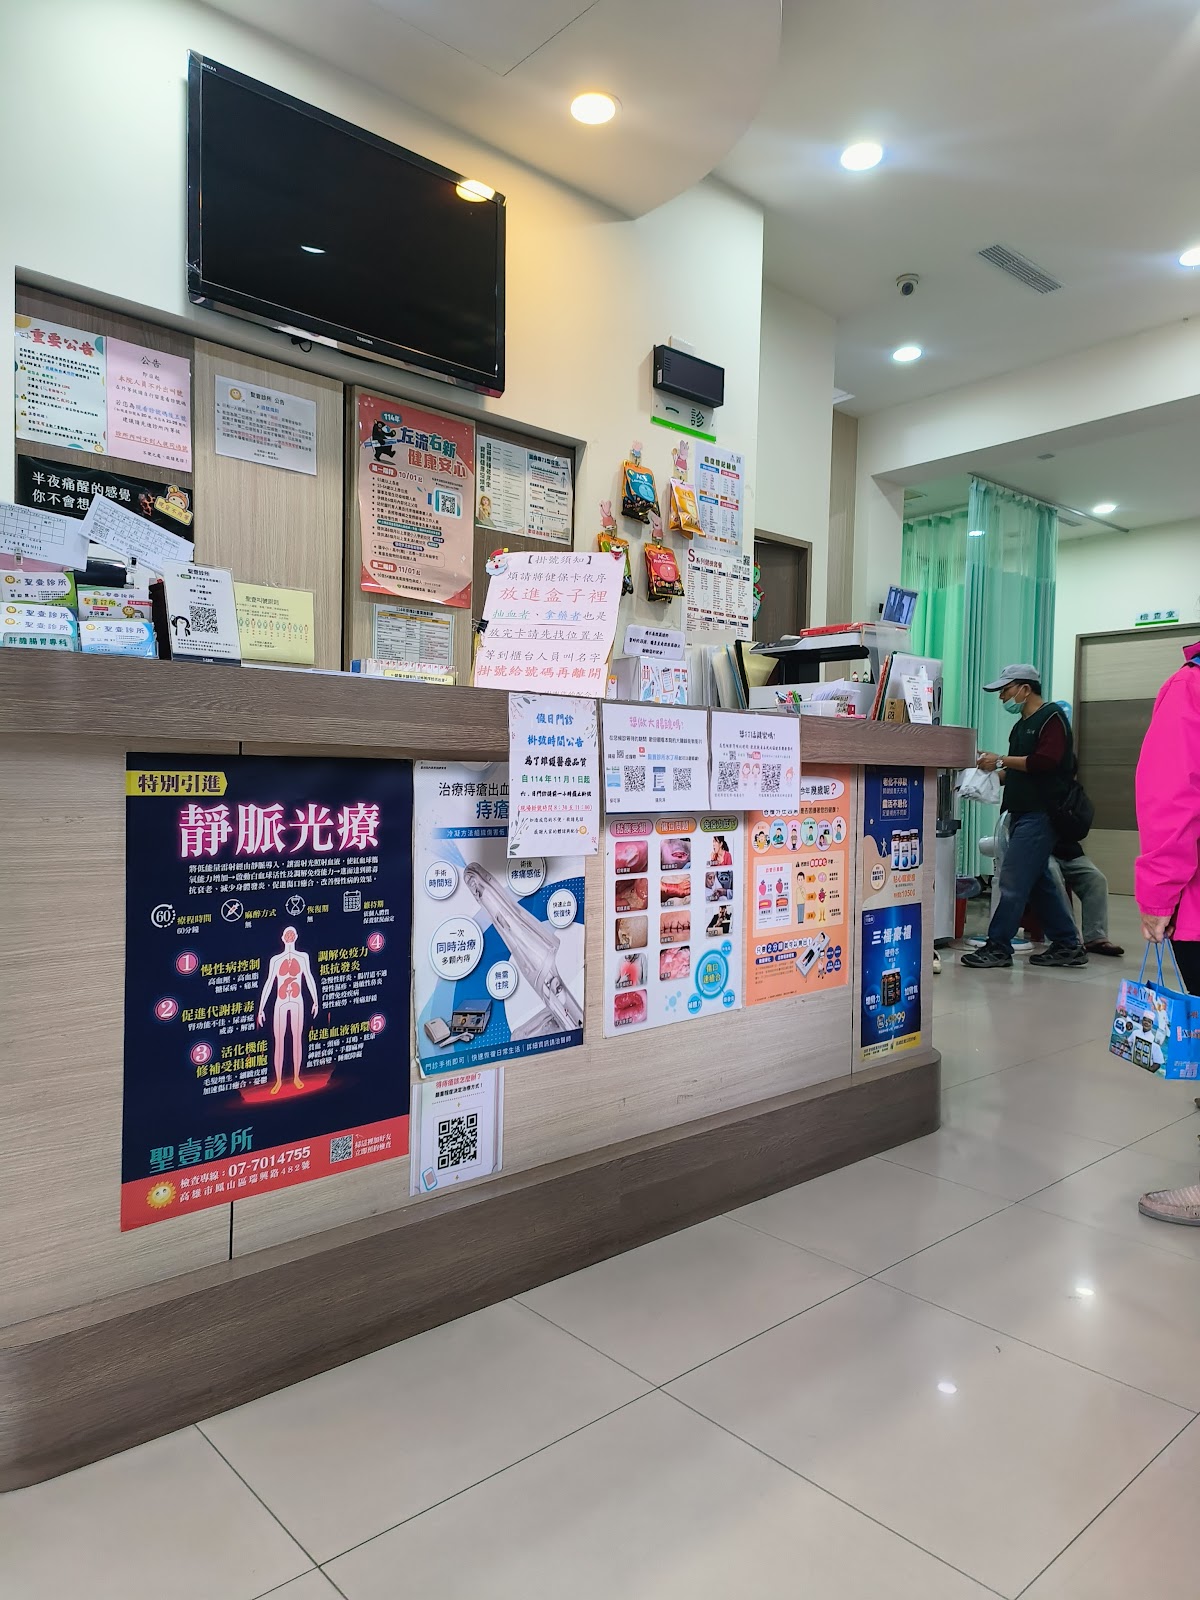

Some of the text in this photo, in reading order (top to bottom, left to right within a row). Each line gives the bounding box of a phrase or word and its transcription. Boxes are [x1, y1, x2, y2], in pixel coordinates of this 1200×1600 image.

[30, 328, 95, 357] 重要公告
[356, 336, 374, 345] TOSHIBA
[141, 355, 162, 368] 公告
[383, 413, 400, 423] 114年
[666, 406, 704, 428] 一診
[400, 426, 457, 458] 左流右新
[408, 448, 466, 478] 健康安心
[32, 470, 132, 503] 半夜痛醒的感覺
[32, 488, 91, 511] 你不會想
[528, 554, 593, 565] 【掛號須知】
[507, 572, 606, 584] 煩請將健保卡依序
[499, 586, 608, 604] 放進盒子裡
[492, 609, 606, 622] 抽血者、拿藥者也是
[488, 628, 604, 641] 放完卡請先找位置坐
[486, 649, 601, 663] 等到櫃台人員叫名字
[477, 665, 602, 680] 掛號給號碼再離開
[536, 713, 574, 726] 假日門診
[527, 734, 584, 748] 掛號時間公告
[524, 756, 588, 768] 為了維護醫療品質
[138, 774, 222, 794] 特別引進
[800, 782, 837, 796] 今年幾歲呢?
[476, 800, 510, 820] 痔瘡
[178, 801, 382, 859] 靜脈光療
[616, 822, 646, 834] 黏膜受損
[660, 820, 690, 832] 傷口問題
[520, 860, 533, 868] 術後
[434, 869, 447, 877] 手術
[511, 868, 542, 879] 疼痛感低
[428, 879, 453, 888] 時間短
[306, 904, 330, 914] 恢復期
[364, 900, 384, 909] 維持期
[156, 909, 171, 924] 60
[176, 914, 212, 926] 療程時間
[244, 908, 277, 920] 麻醉方式
[553, 909, 571, 918] 恢復快
[176, 926, 200, 934] 60分鐘
[449, 929, 465, 938] 一次
[370, 934, 381, 949] 4
[436, 938, 476, 954] 同時治療
[318, 946, 369, 962] 調解免疫力
[441, 954, 471, 966] 多顆內痔
[182, 954, 191, 970] 1
[200, 958, 261, 977] 慢性病控制
[320, 961, 362, 976] 抵抗發炎
[706, 963, 719, 973] 傷口
[495, 970, 510, 980] 無需
[495, 981, 510, 991] 住院
[160, 1000, 172, 1018] 2
[180, 1000, 256, 1022] 促進代謝排毒
[372, 1016, 382, 1031] 5
[308, 1020, 370, 1042] 促進血液循環
[195, 1044, 208, 1062] 3
[220, 1040, 268, 1059] 活化機能
[425, 1056, 466, 1072] 門診手術即可
[471, 1046, 521, 1062] 快速恢復日常生活
[196, 1054, 268, 1079] 修補受損細胞
[149, 1125, 254, 1174] 聖壹診所
[178, 1160, 312, 1203] 高雄市鳳山區瑞興路482號
